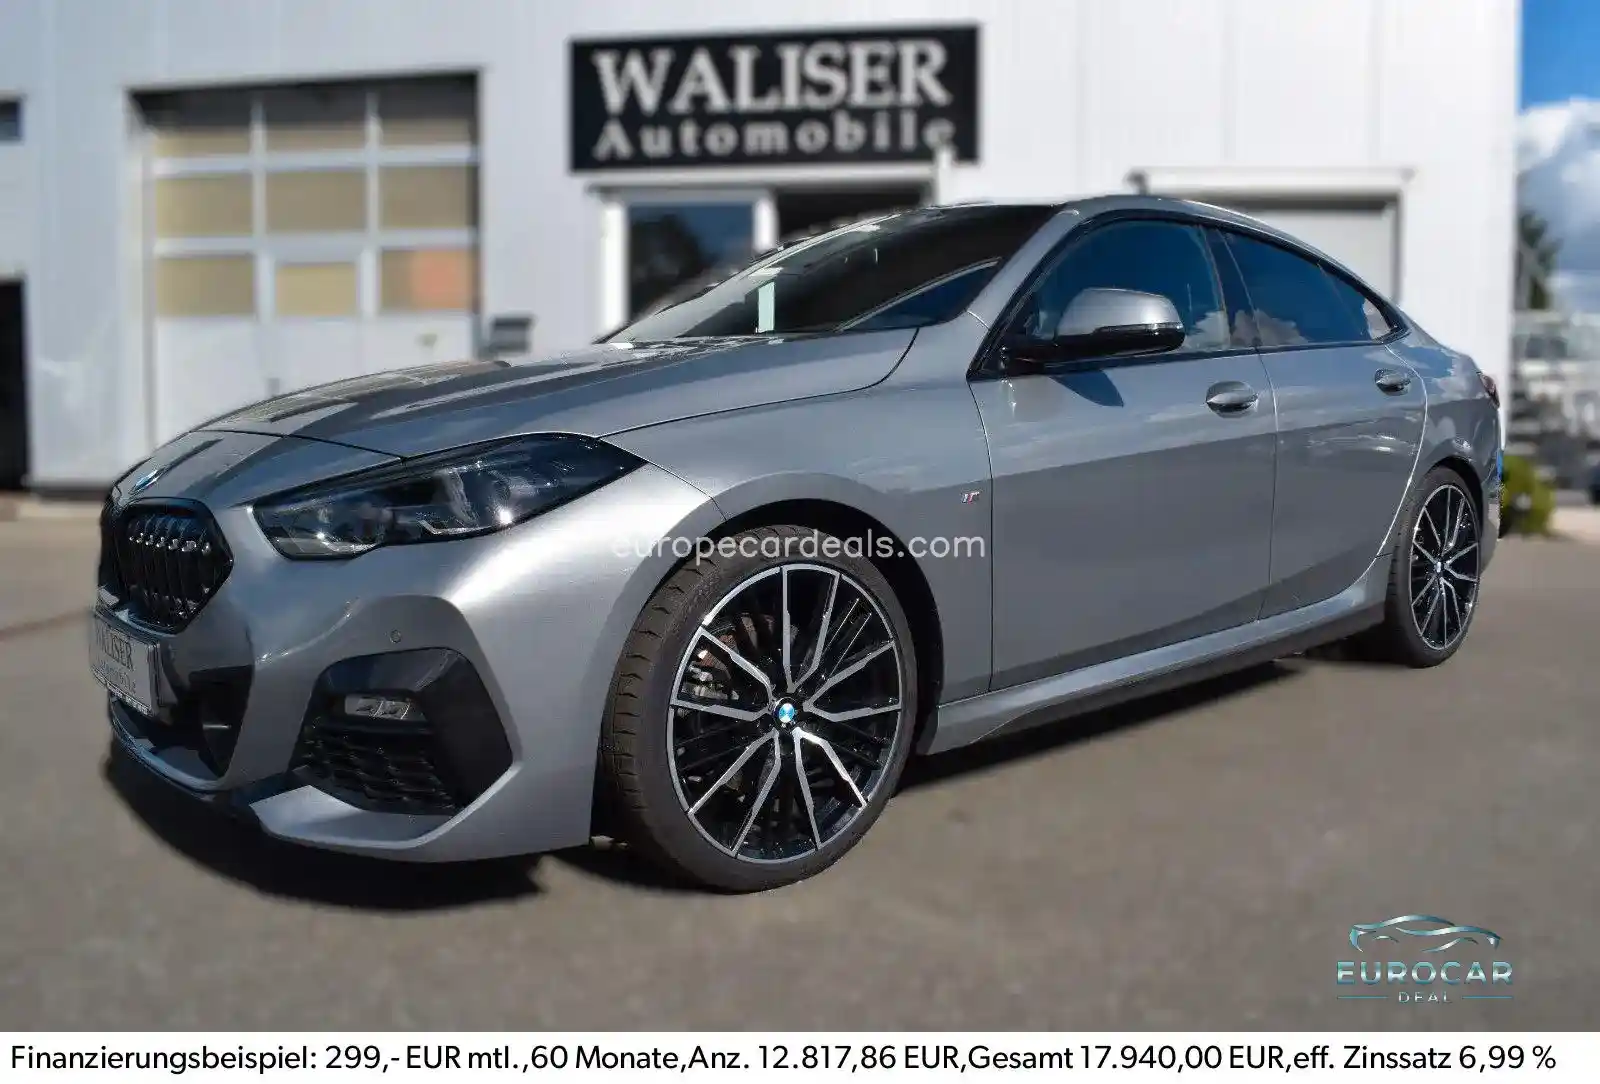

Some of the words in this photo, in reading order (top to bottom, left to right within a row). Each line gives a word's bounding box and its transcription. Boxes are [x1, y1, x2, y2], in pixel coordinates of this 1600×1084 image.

[591, 38, 953, 117] WALISER
[592, 110, 956, 160] Automobile
[94, 620, 134, 671] LISER
